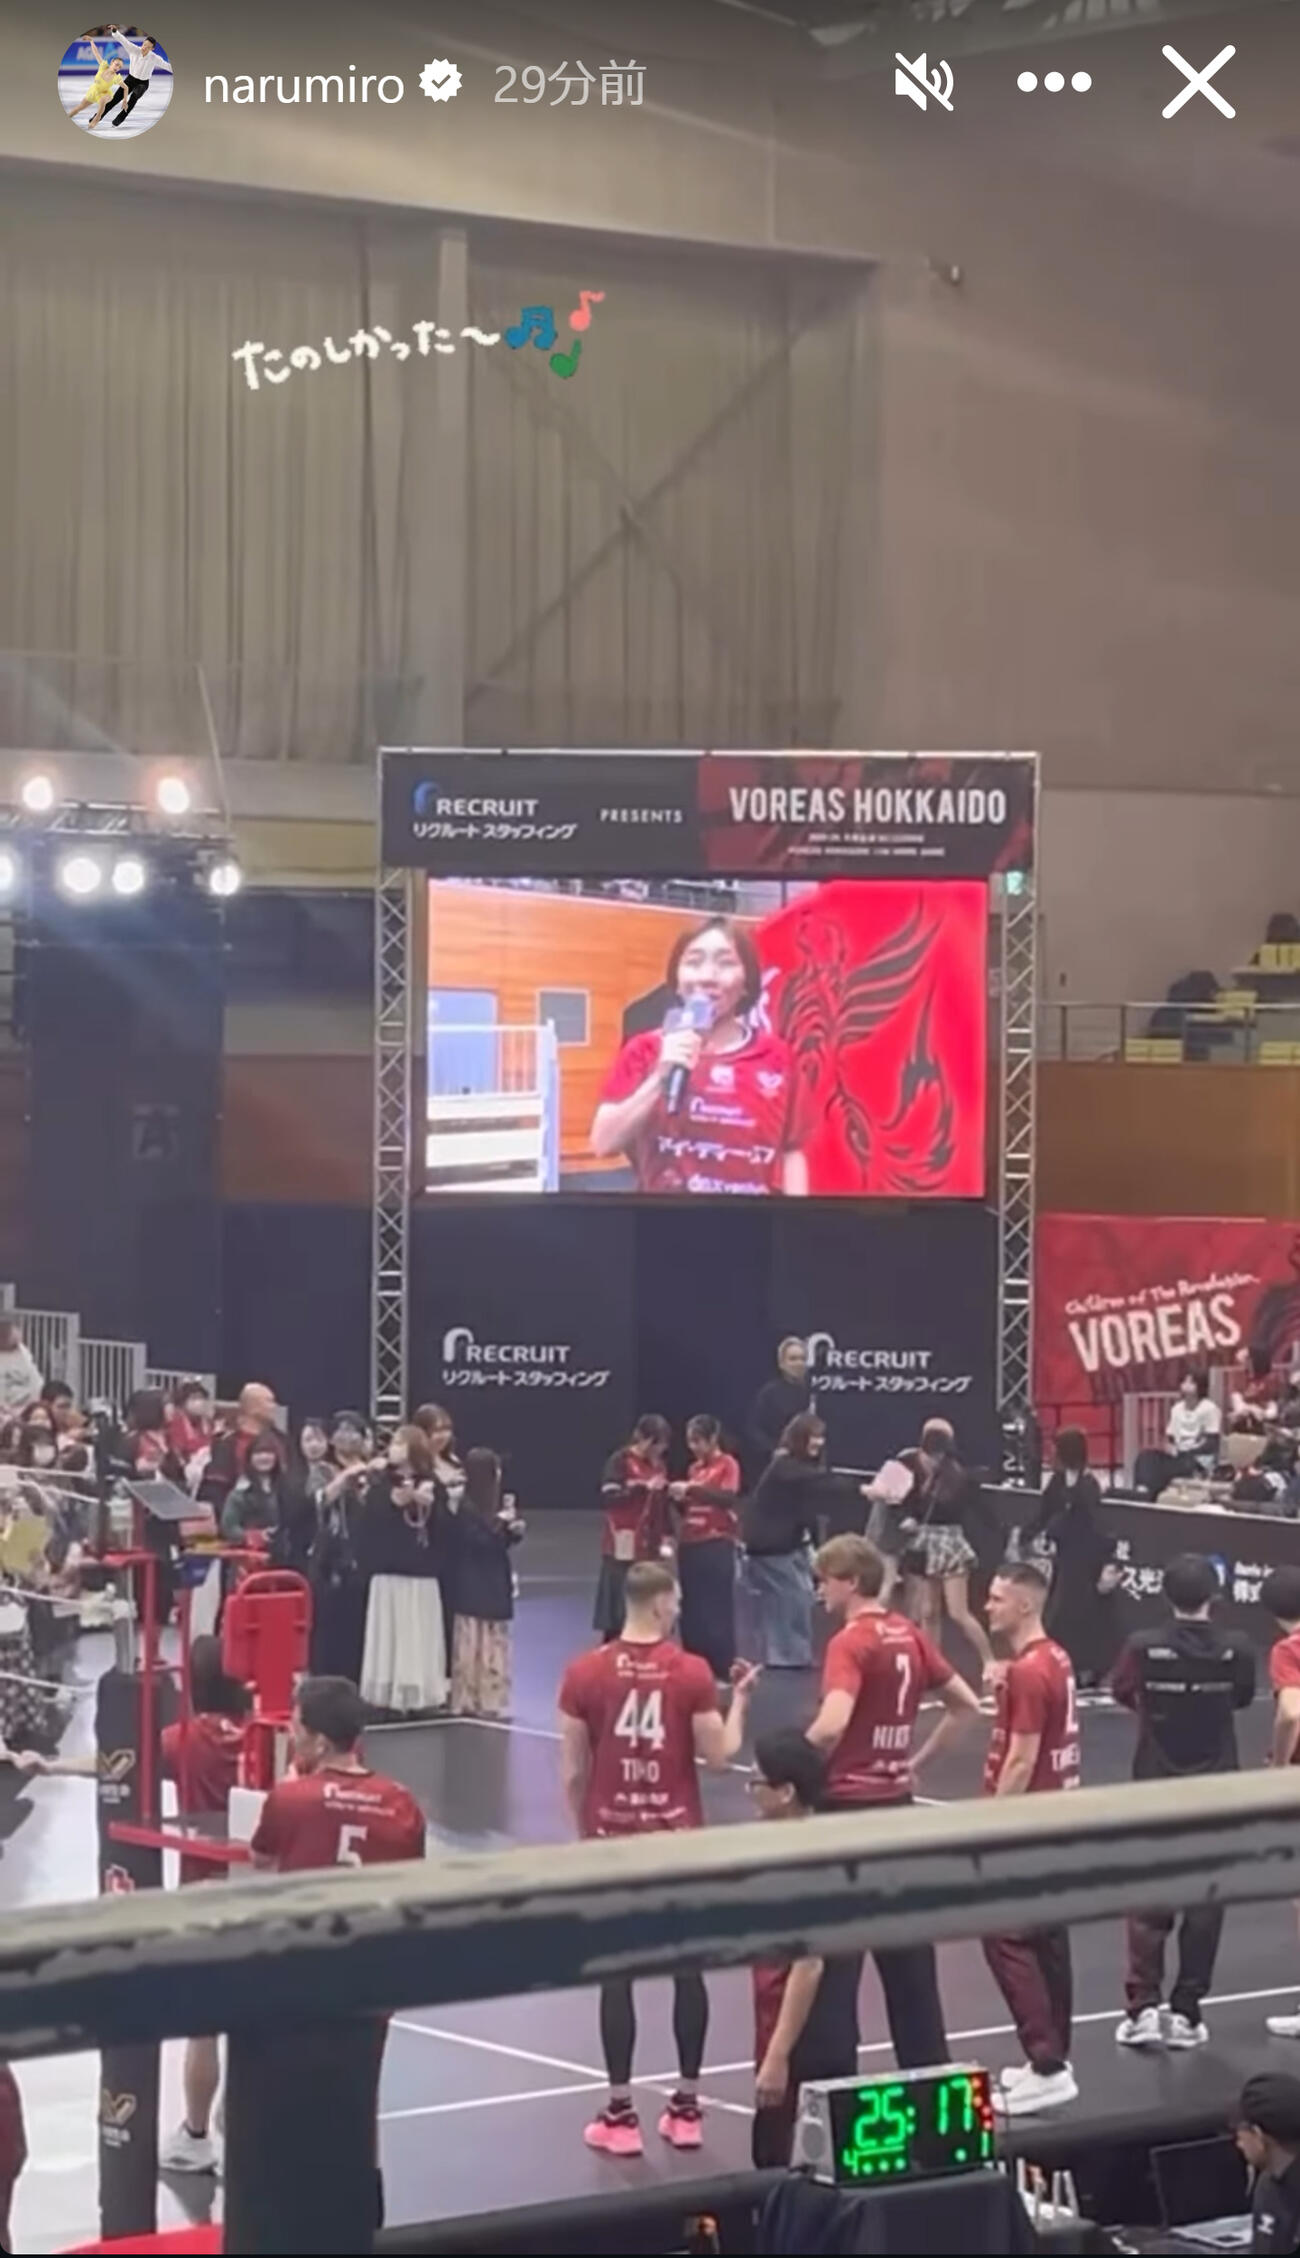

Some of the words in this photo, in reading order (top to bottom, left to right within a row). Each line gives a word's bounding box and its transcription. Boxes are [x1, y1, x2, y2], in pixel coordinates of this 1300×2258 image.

[436, 799, 539, 817] RECRUIT
[600, 808, 683, 823] PRESENTS
[729, 787, 845, 824] VOREAS
[853, 788, 1007, 825] HOKKAIDO
[466, 1344, 571, 1363] RECRUIT
[1067, 1293, 1242, 1373] VOREAS
[827, 1350, 932, 1368] RECRUIT
[895, 1653, 911, 1716] 7
[614, 1688, 665, 1750] 44
[337, 1824, 367, 1868] 5
[854, 2086, 906, 2147] 25
